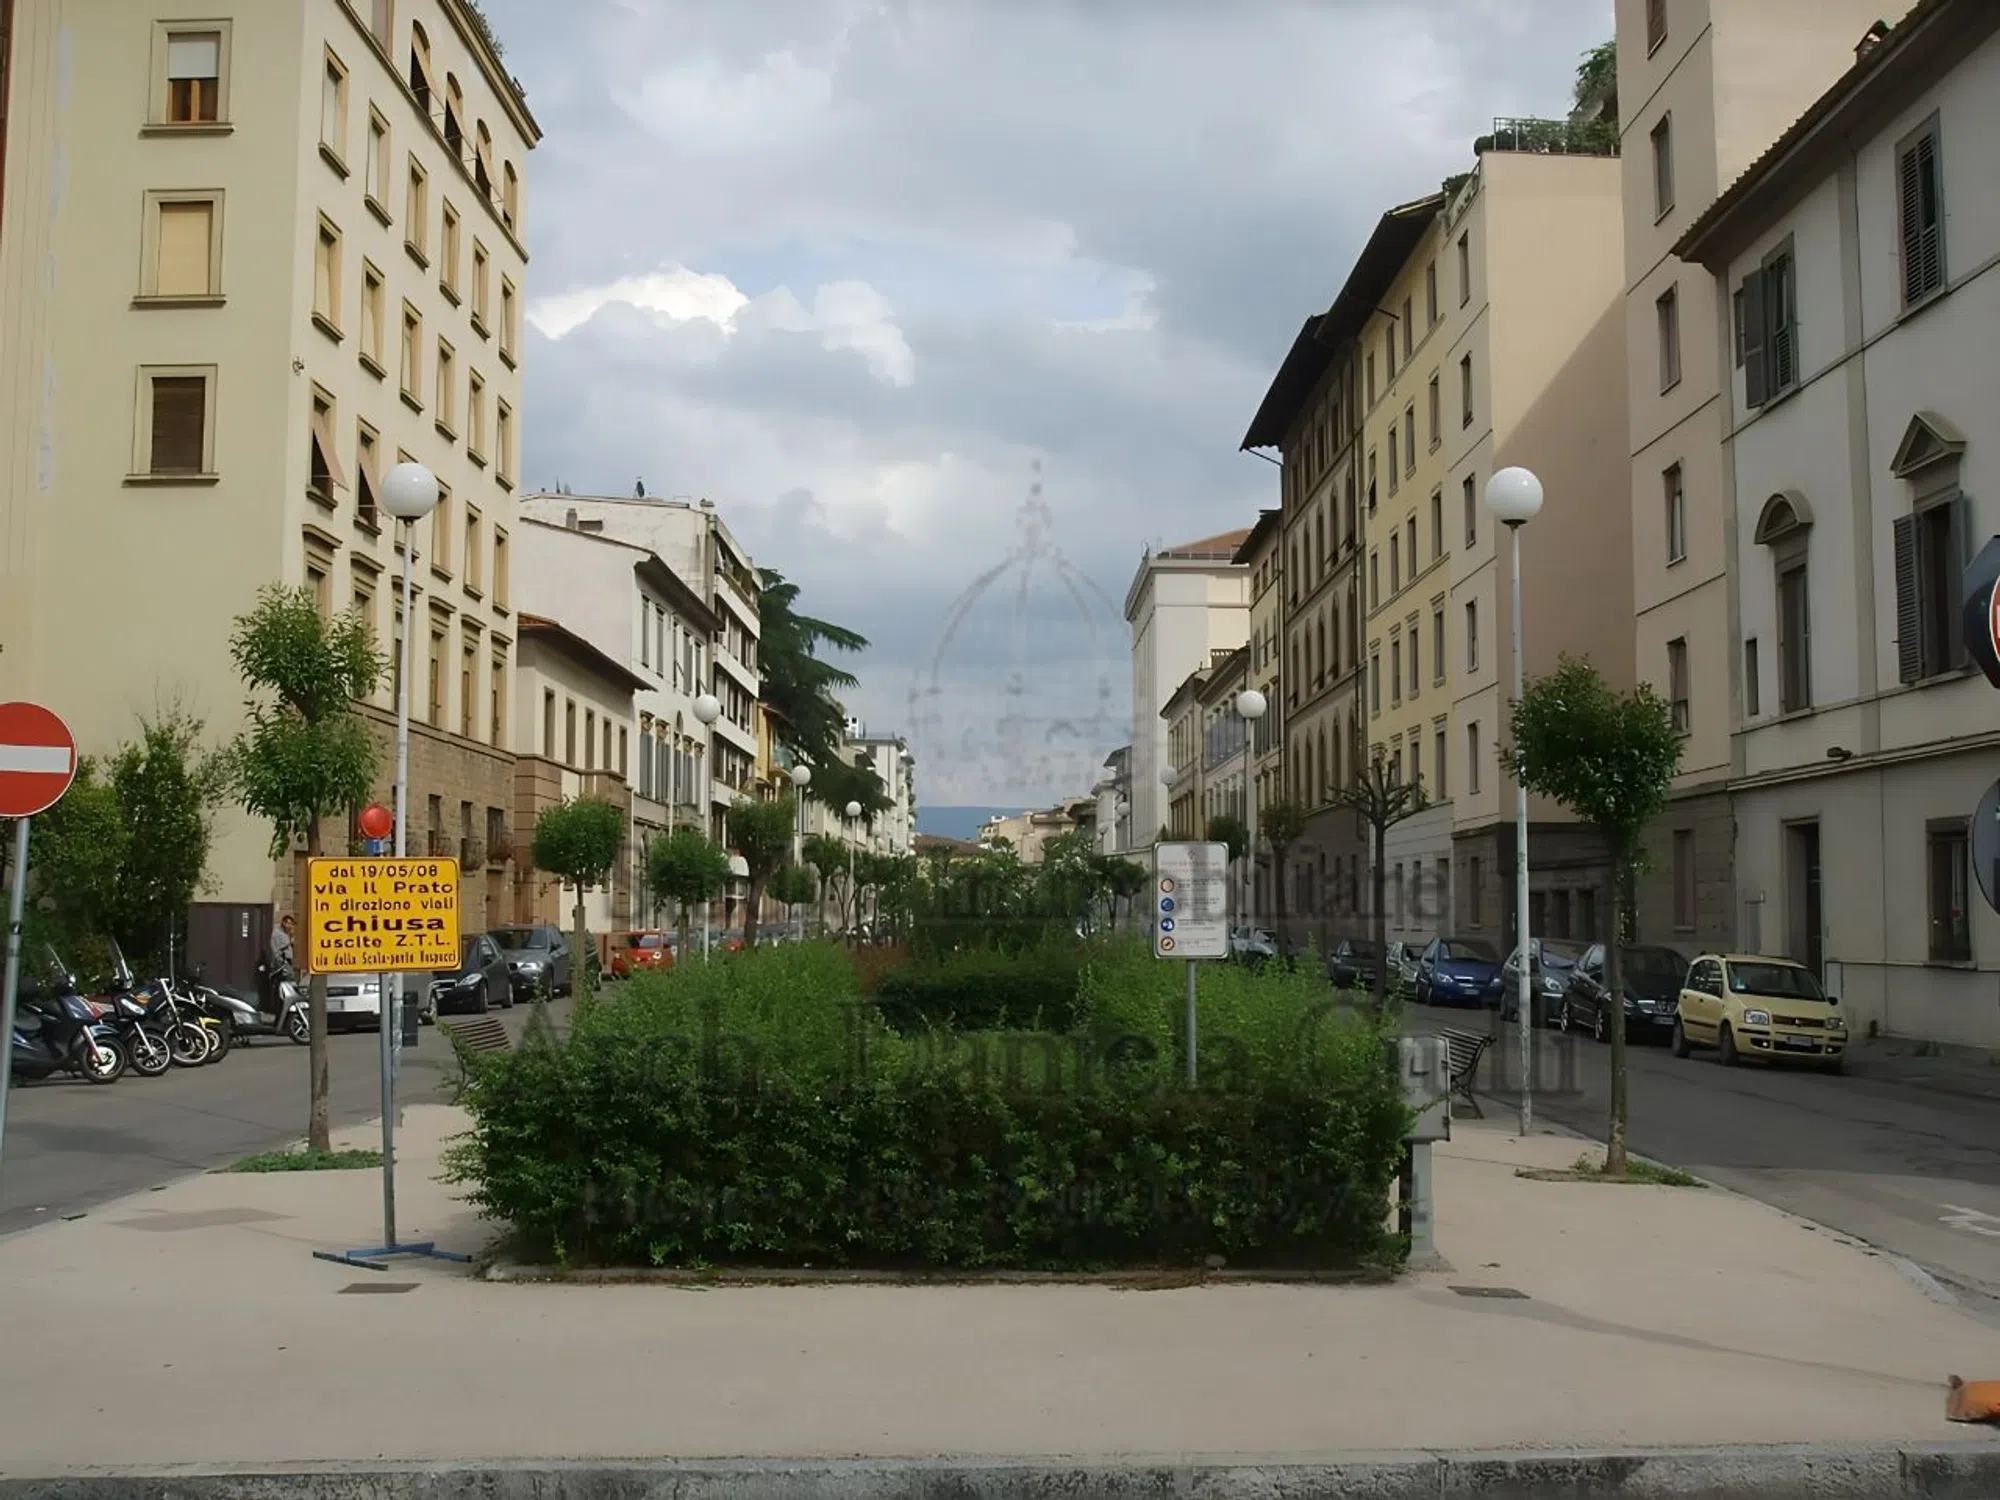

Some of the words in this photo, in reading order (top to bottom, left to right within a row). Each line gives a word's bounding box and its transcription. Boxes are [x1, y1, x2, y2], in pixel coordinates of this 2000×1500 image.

[329, 865, 356, 878] dal
[360, 864, 439, 880] 19/05/08
[314, 881, 348, 895] via
[393, 881, 454, 894] Prato
[315, 898, 330, 912] in
[340, 897, 411, 912] direzione
[420, 896, 454, 910] viali
[323, 915, 445, 933] chiusa
[395, 933, 451, 947] Z.T.L.
